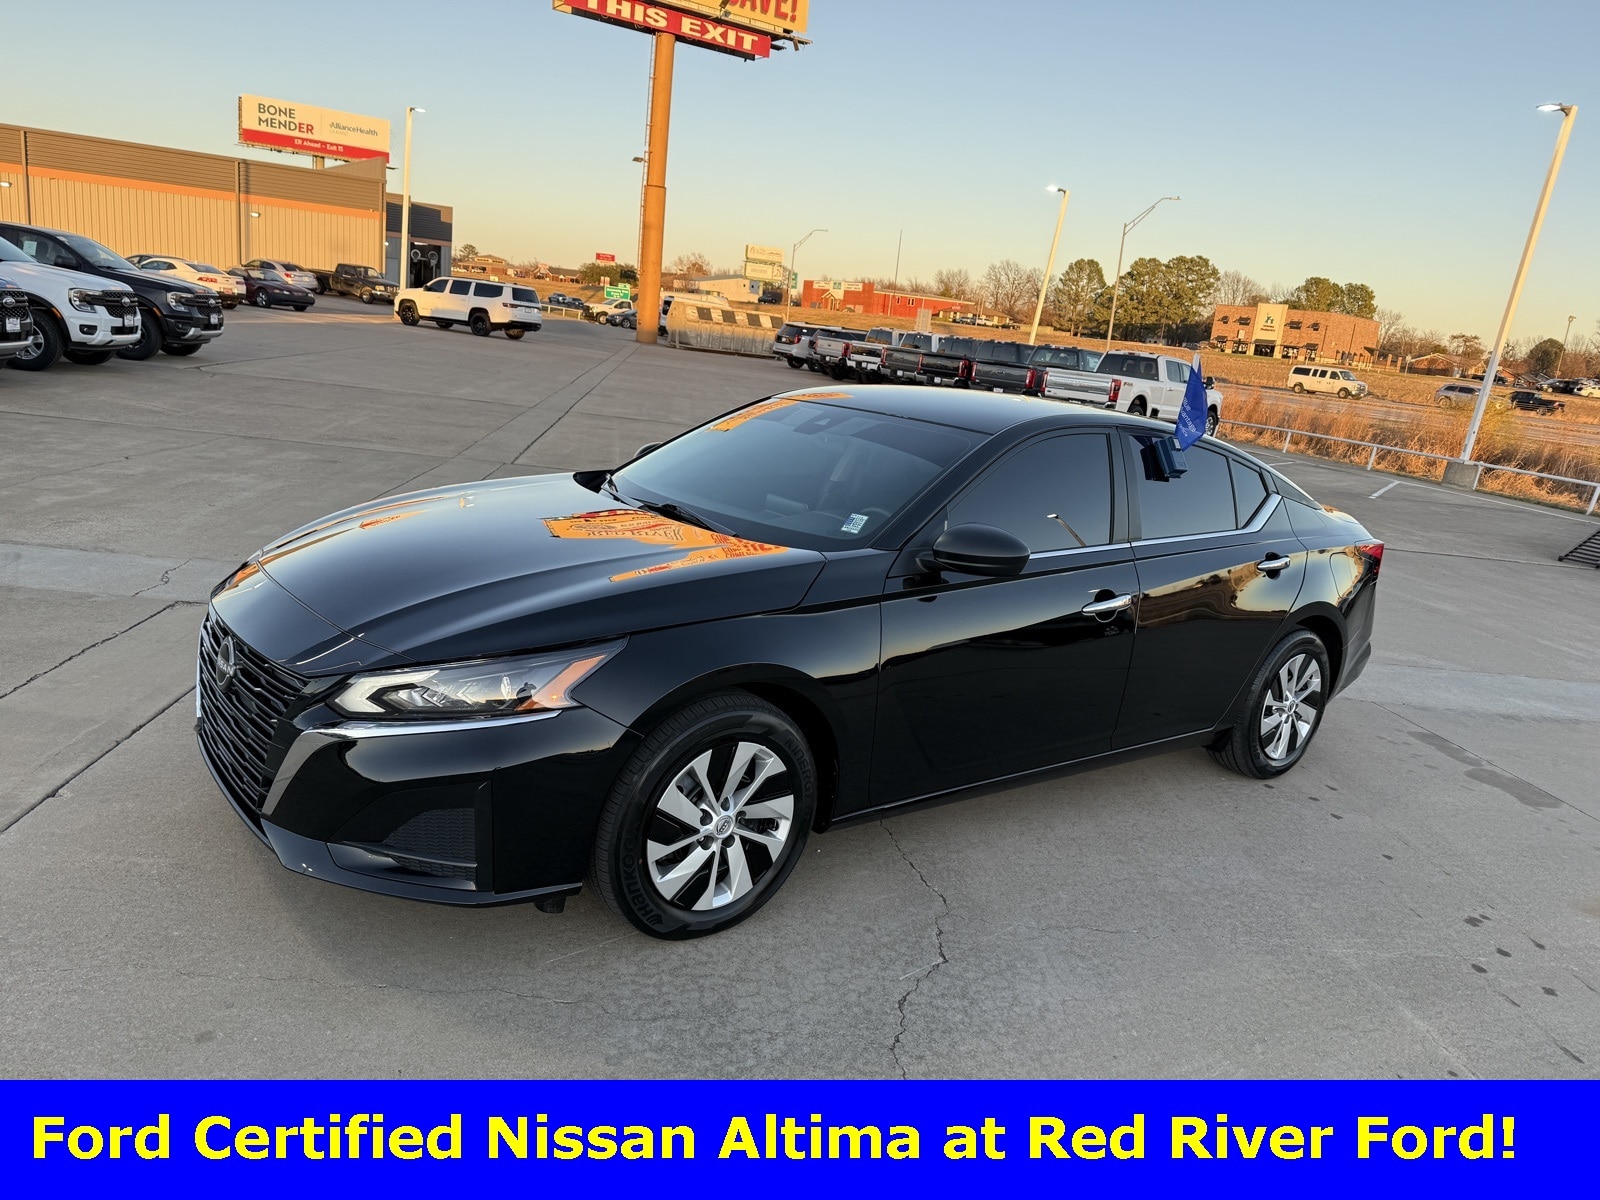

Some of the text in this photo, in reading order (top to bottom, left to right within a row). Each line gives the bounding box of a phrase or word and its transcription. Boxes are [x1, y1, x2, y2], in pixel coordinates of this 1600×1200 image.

[681, 18, 759, 51] EXIT
[258, 103, 296, 119] BONE
[258, 117, 314, 135] MENDER
[329, 122, 378, 137] AllianceHealth
[303, 140, 321, 148] Ahead
